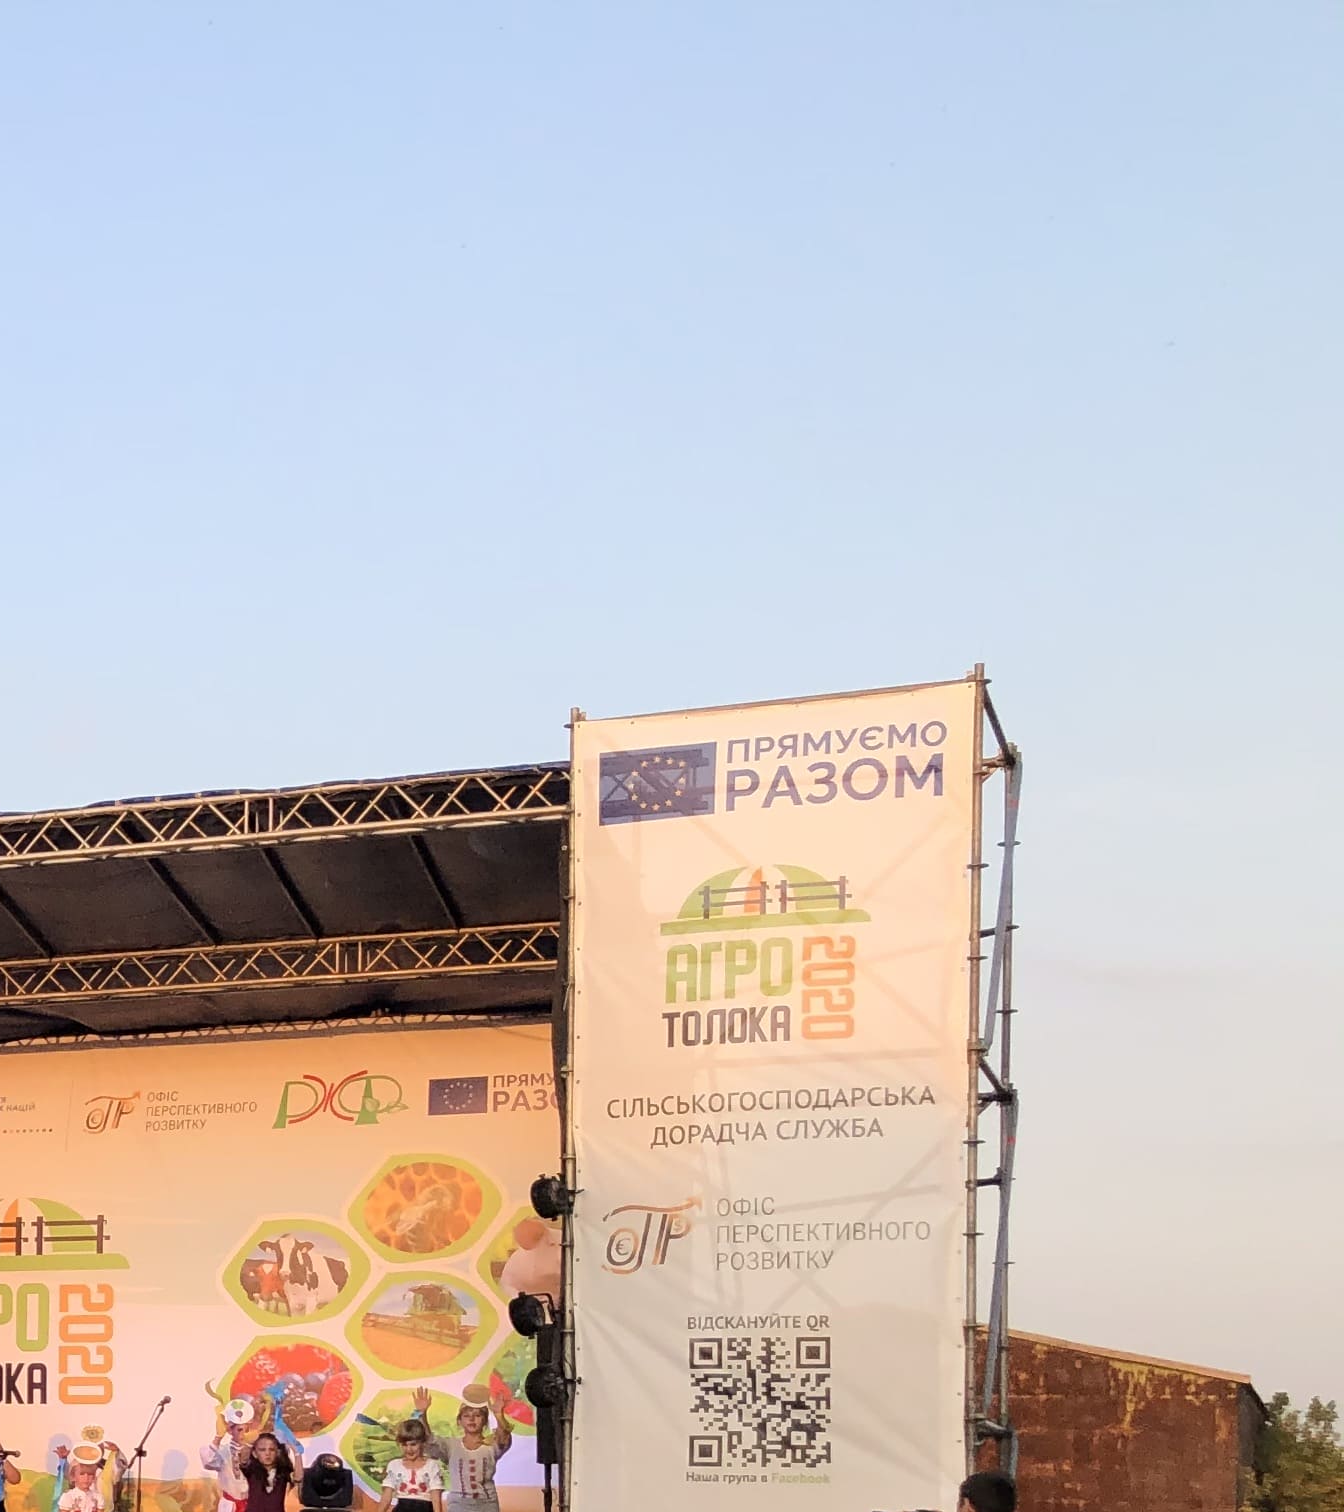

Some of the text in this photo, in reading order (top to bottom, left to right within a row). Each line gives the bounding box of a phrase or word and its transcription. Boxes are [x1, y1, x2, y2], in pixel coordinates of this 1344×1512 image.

[727, 720, 948, 763] ПРЯМУЄМО
[725, 752, 944, 812] РАЗОМ
[665, 937, 793, 1004] АГРО
[801, 935, 856, 1040] 2020
[661, 1005, 791, 1048] ТОЛОКА
[146, 1090, 179, 1103] ОФІС
[146, 1101, 258, 1117] ПЕРСПЕКТИВНОГО
[607, 1085, 936, 1119] СІЛЬСЬКОГОСПОДАРСЬКА
[145, 1119, 207, 1132] РОЗВИТКУ
[650, 1117, 884, 1149] ДОРАДЧА СЛУЖБА
[716, 1196, 776, 1217] ОФІС
[716, 1221, 930, 1244] ПЕРСПЕКТИВНОГО
[716, 1251, 834, 1271] РОЗВИТКУ
[687, 1313, 830, 1331] ВІДСКАНУЙТЕ QR
[58, 1283, 114, 1405] 2020
[686, 1472, 719, 1482] Наша
[723, 1474, 757, 1485] група
